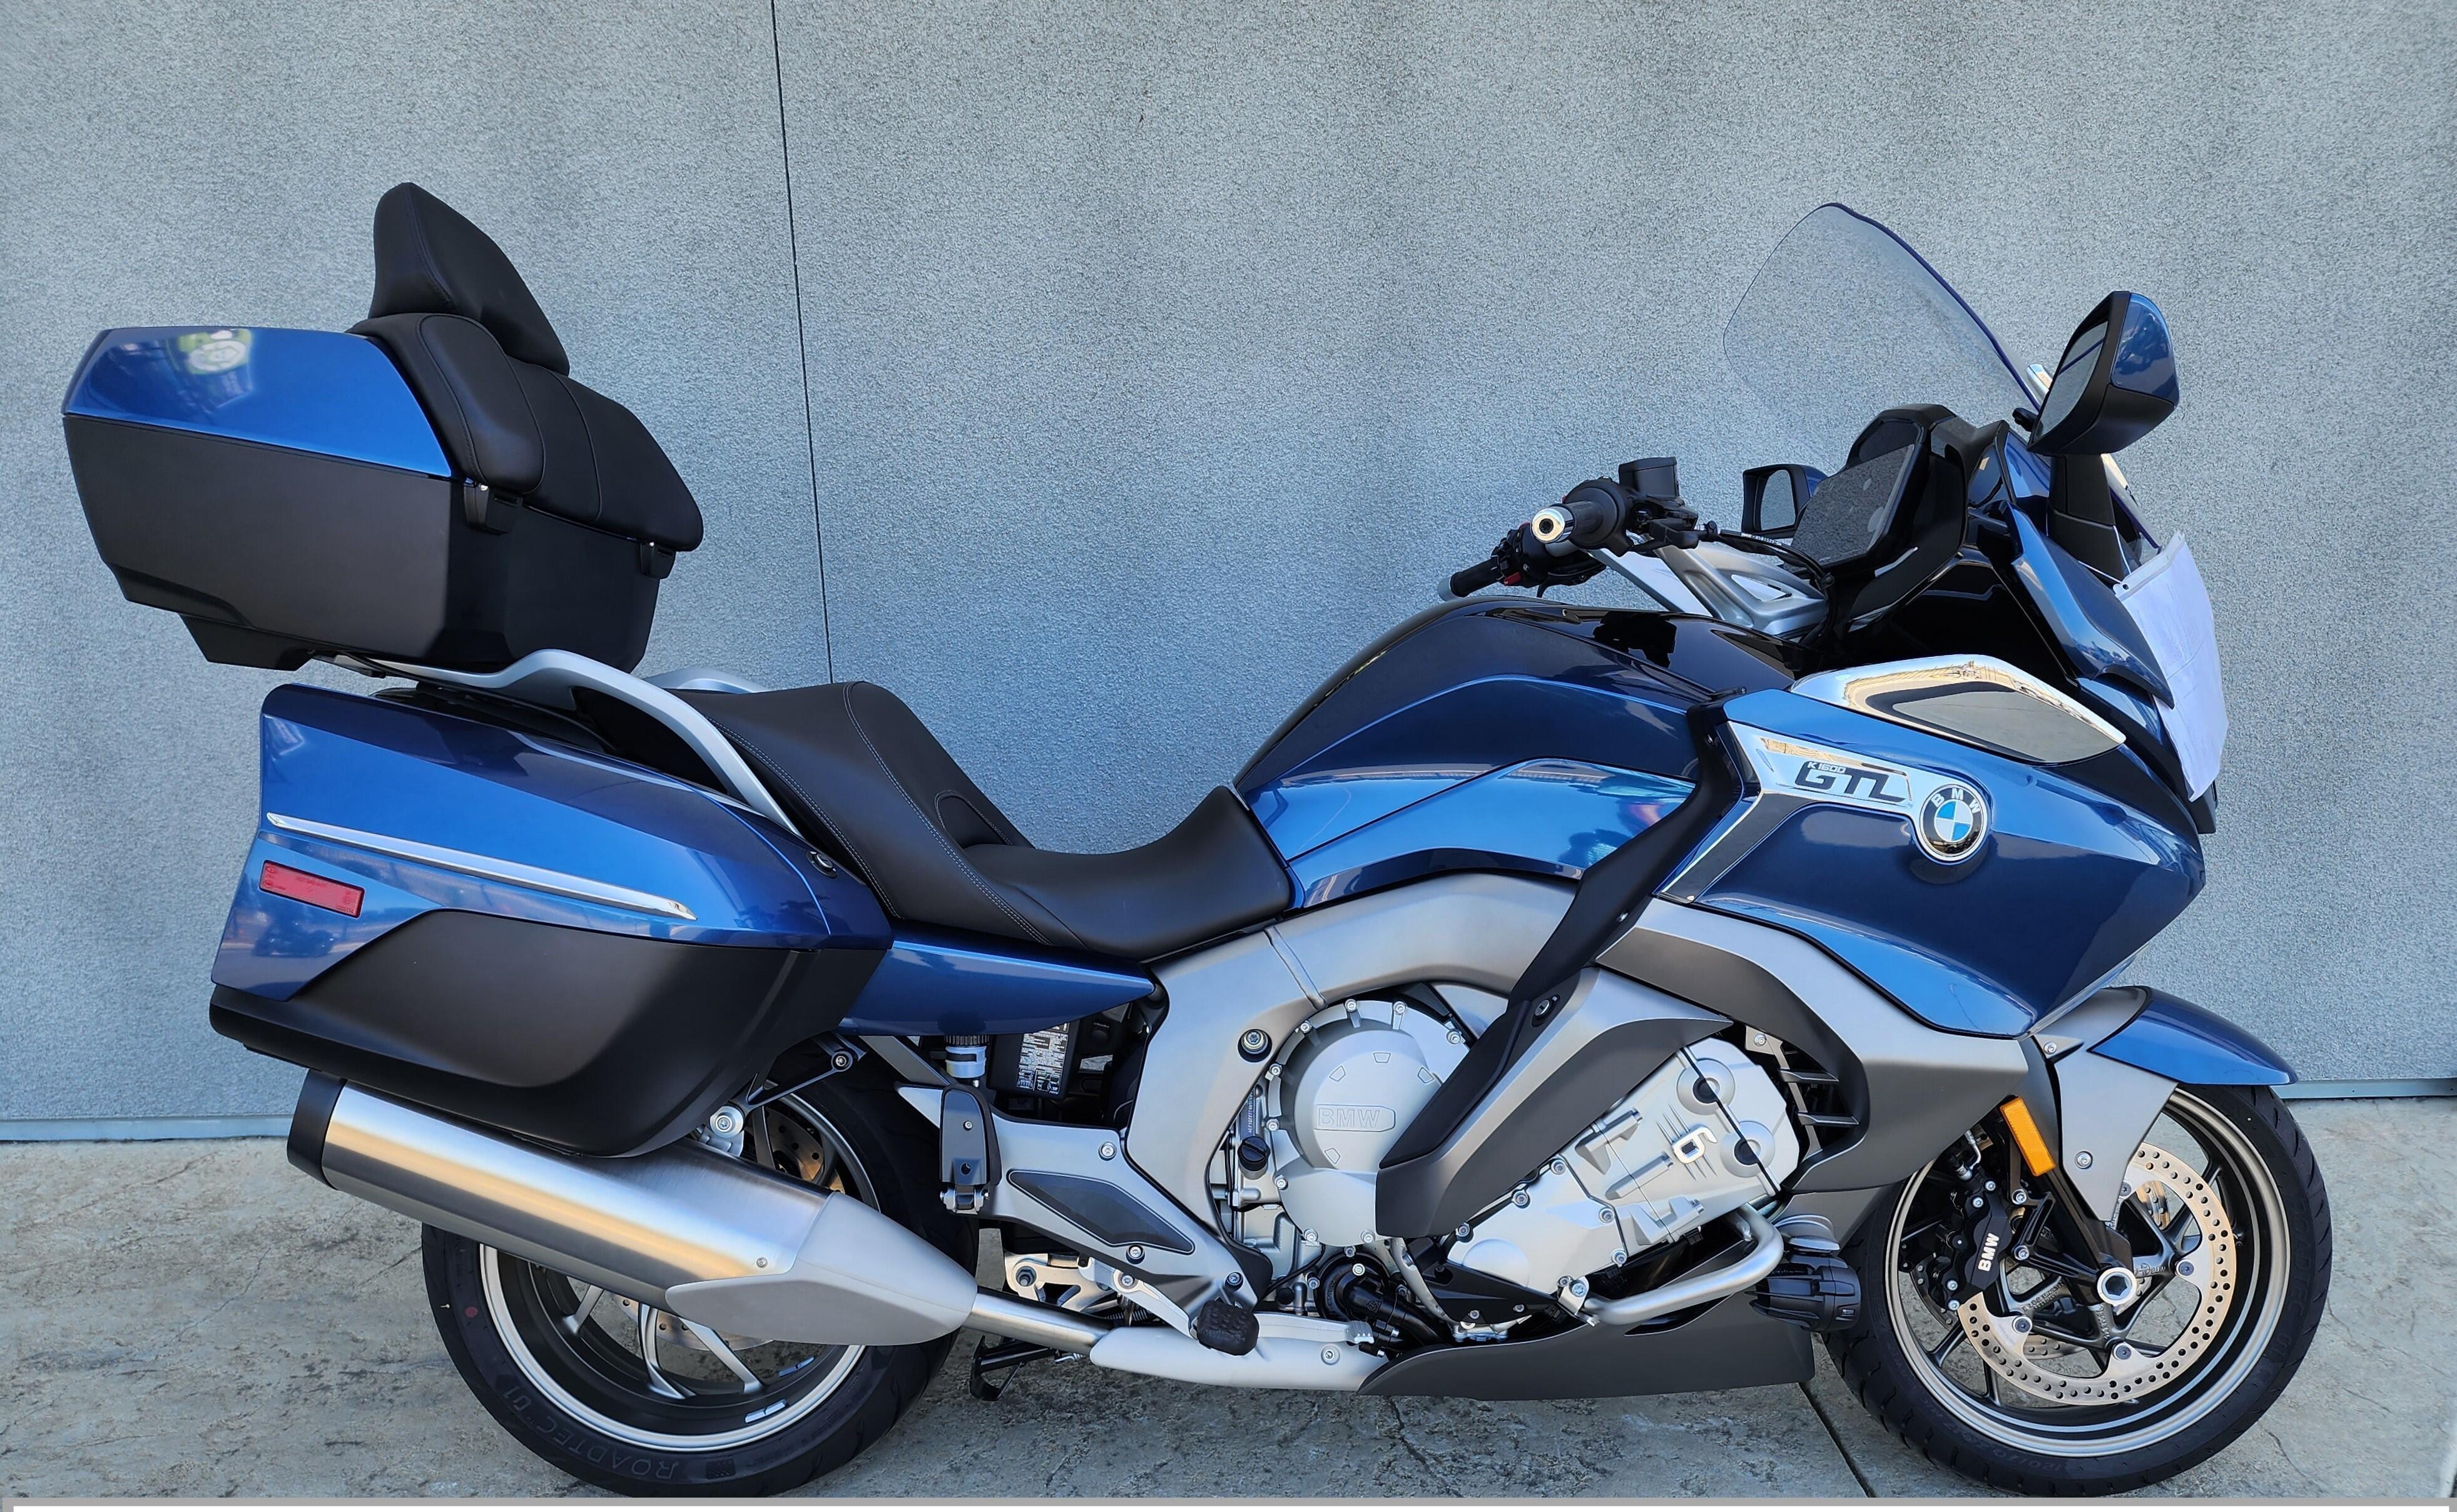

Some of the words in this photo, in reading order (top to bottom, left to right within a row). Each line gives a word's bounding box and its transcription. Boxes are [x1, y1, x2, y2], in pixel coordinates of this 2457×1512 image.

[1794, 761, 1906, 803] GTL
[1931, 788, 1981, 814] BMW
[1318, 1108, 1380, 1127] BMW
[1978, 1232, 2000, 1271] BMW
